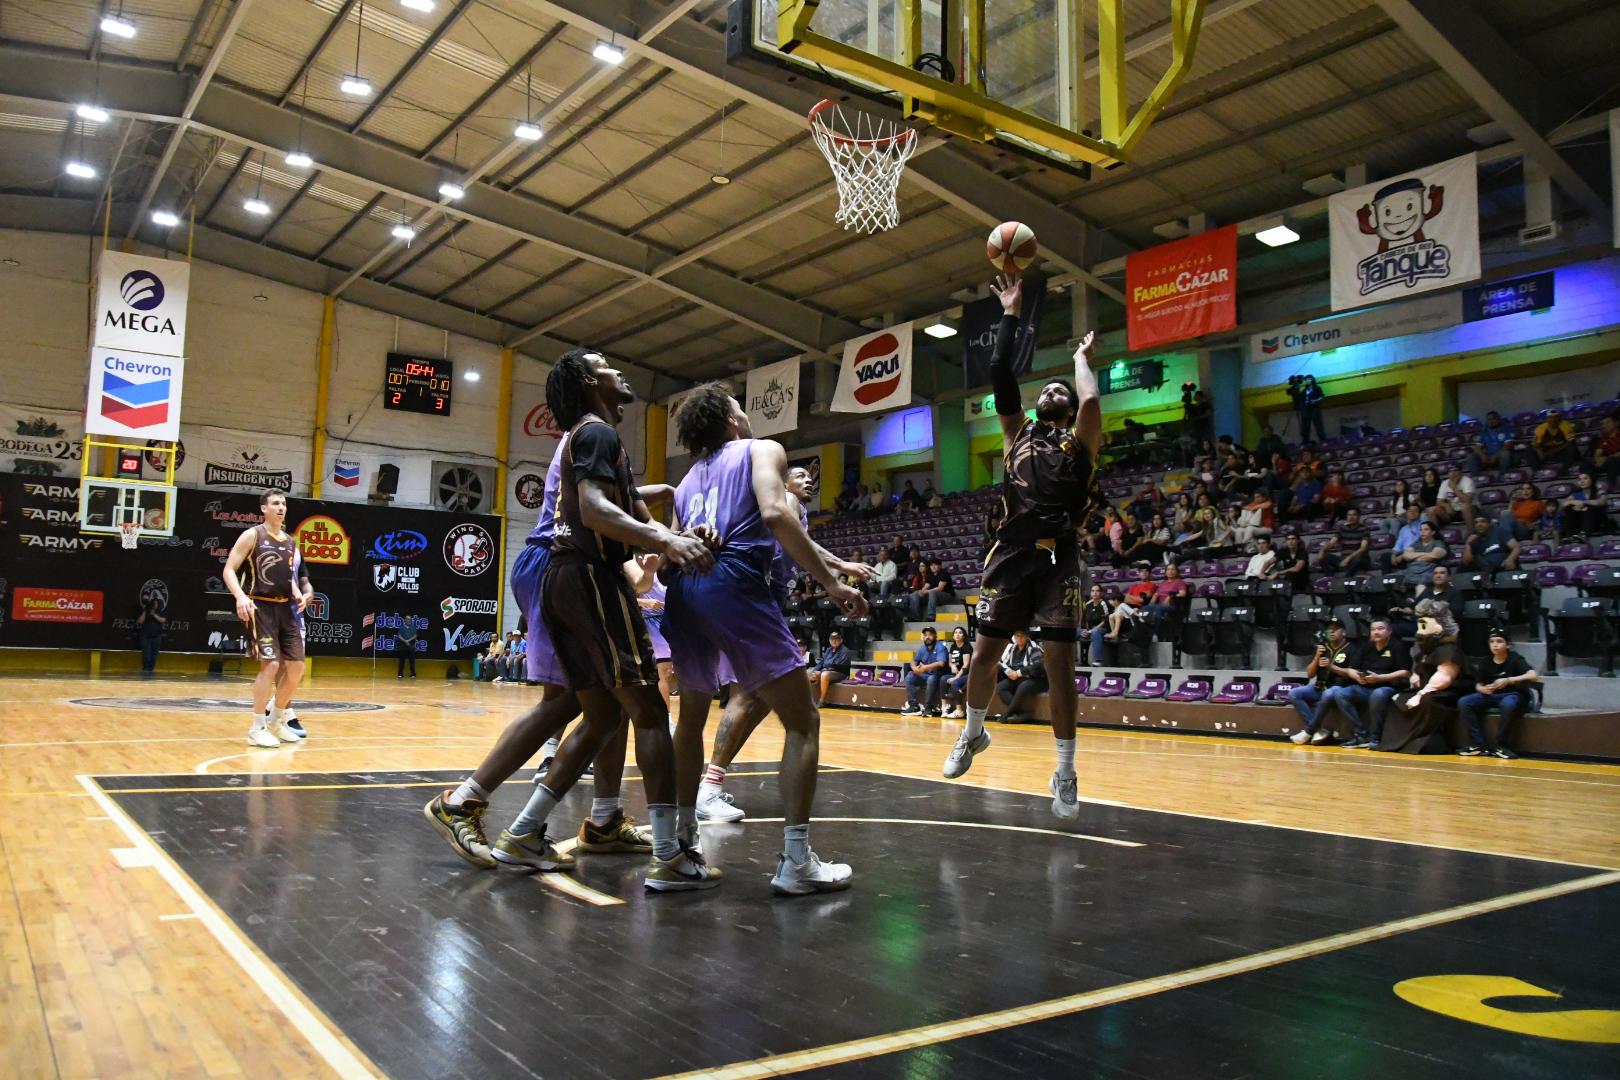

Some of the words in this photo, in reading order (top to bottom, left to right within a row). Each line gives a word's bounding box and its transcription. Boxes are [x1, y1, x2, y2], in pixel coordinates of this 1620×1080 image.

[1146, 254, 1214, 279] FARMACIAS
[1360, 248, 1447, 287] Tanque
[1519, 281, 1537, 294] DE
[1482, 298, 1536, 315] PRENSA
[104, 310, 176, 335] MEGA
[1283, 326, 1341, 349] Chevron
[104, 356, 173, 377] Chevron
[855, 353, 900, 384] YAQUI
[392, 392, 402, 404] 2
[435, 397, 444, 410] 3
[54, 440, 84, 461] 23
[122, 459, 138, 470] 20
[208, 466, 289, 489] INSURGENTES
[314, 521, 329, 532] EL
[28, 534, 95, 550] ARMY
[300, 530, 344, 546] POLLO
[300, 544, 342, 560] LOCO
[397, 566, 420, 578] CLUB
[464, 562, 487, 574] PARK
[396, 582, 420, 591] POLLOS
[454, 599, 497, 613] SPORADE
[375, 611, 429, 630] debte
